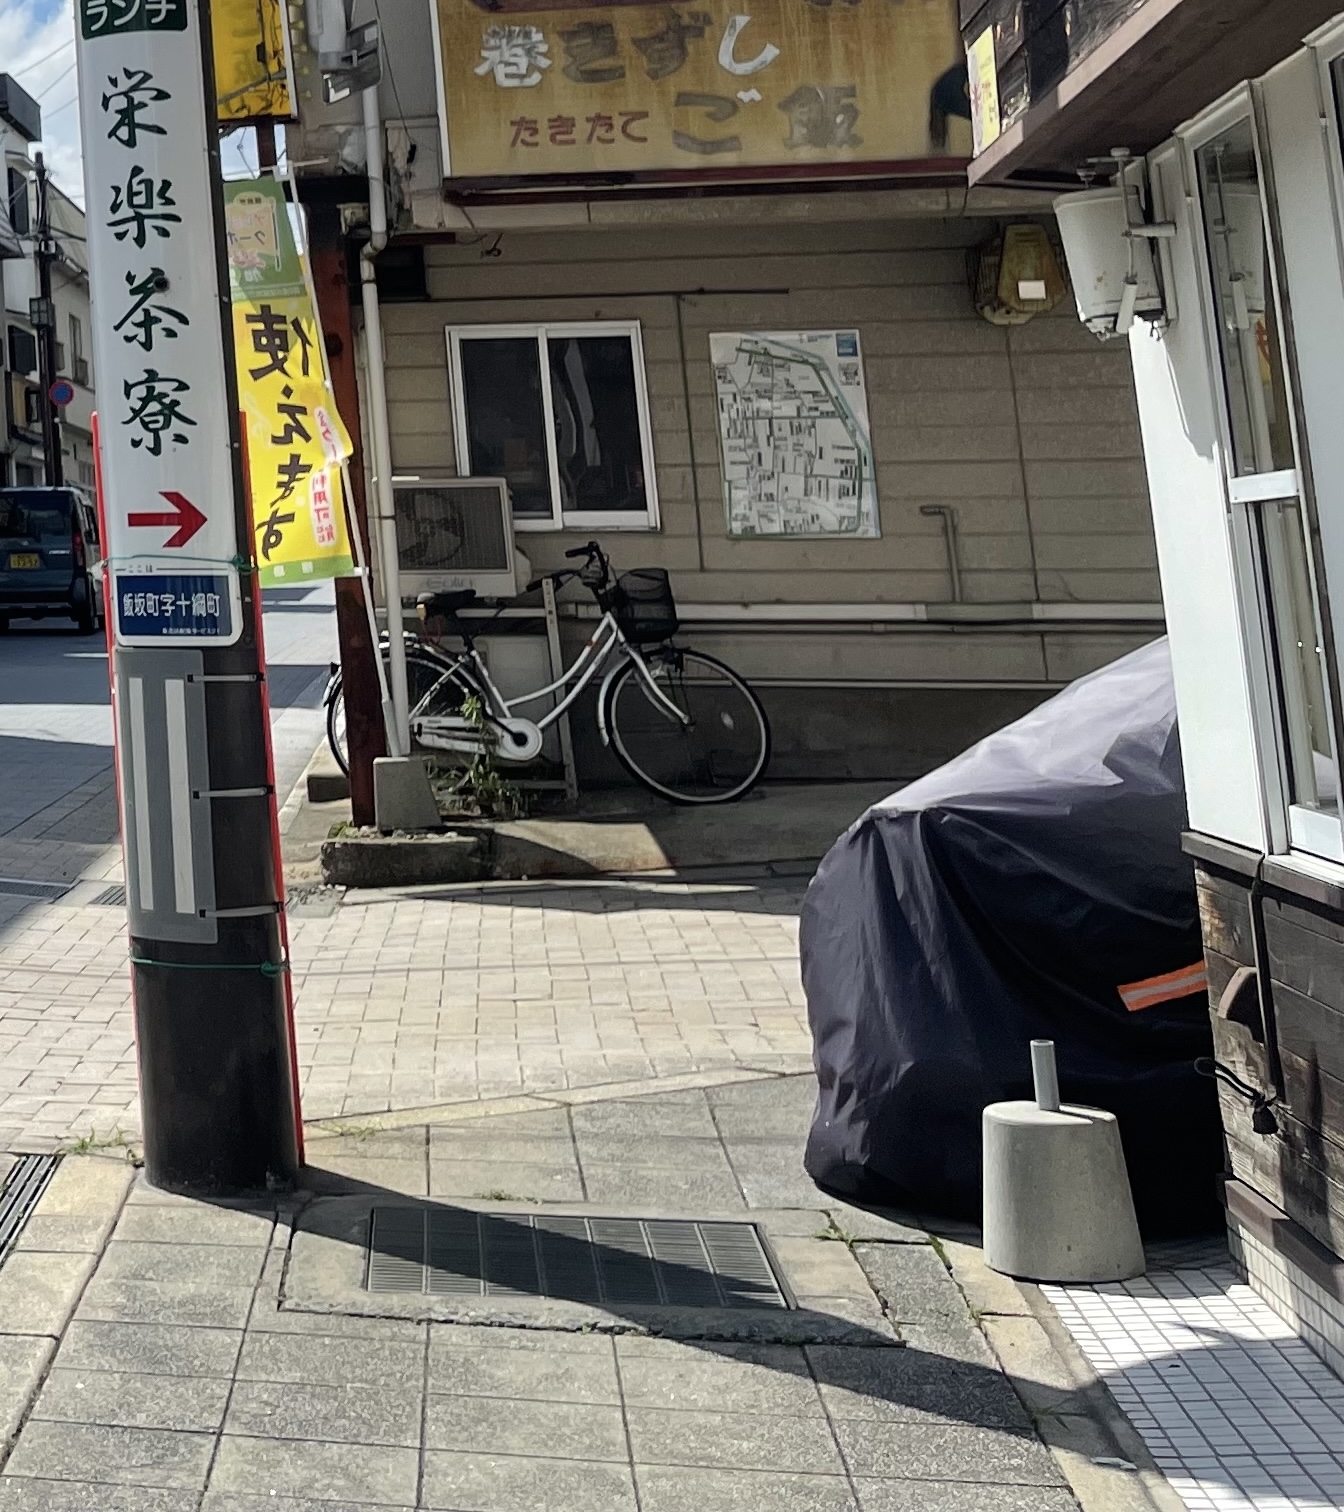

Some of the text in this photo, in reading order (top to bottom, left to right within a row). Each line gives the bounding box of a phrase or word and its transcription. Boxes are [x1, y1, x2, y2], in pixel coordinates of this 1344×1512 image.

[473, 10, 780, 89] 巻きずし
[510, 110, 650, 149] たきたて
[98, 67, 198, 456] 栄楽茶寮
[123, 592, 220, 617] 飯坂町字十綱町
